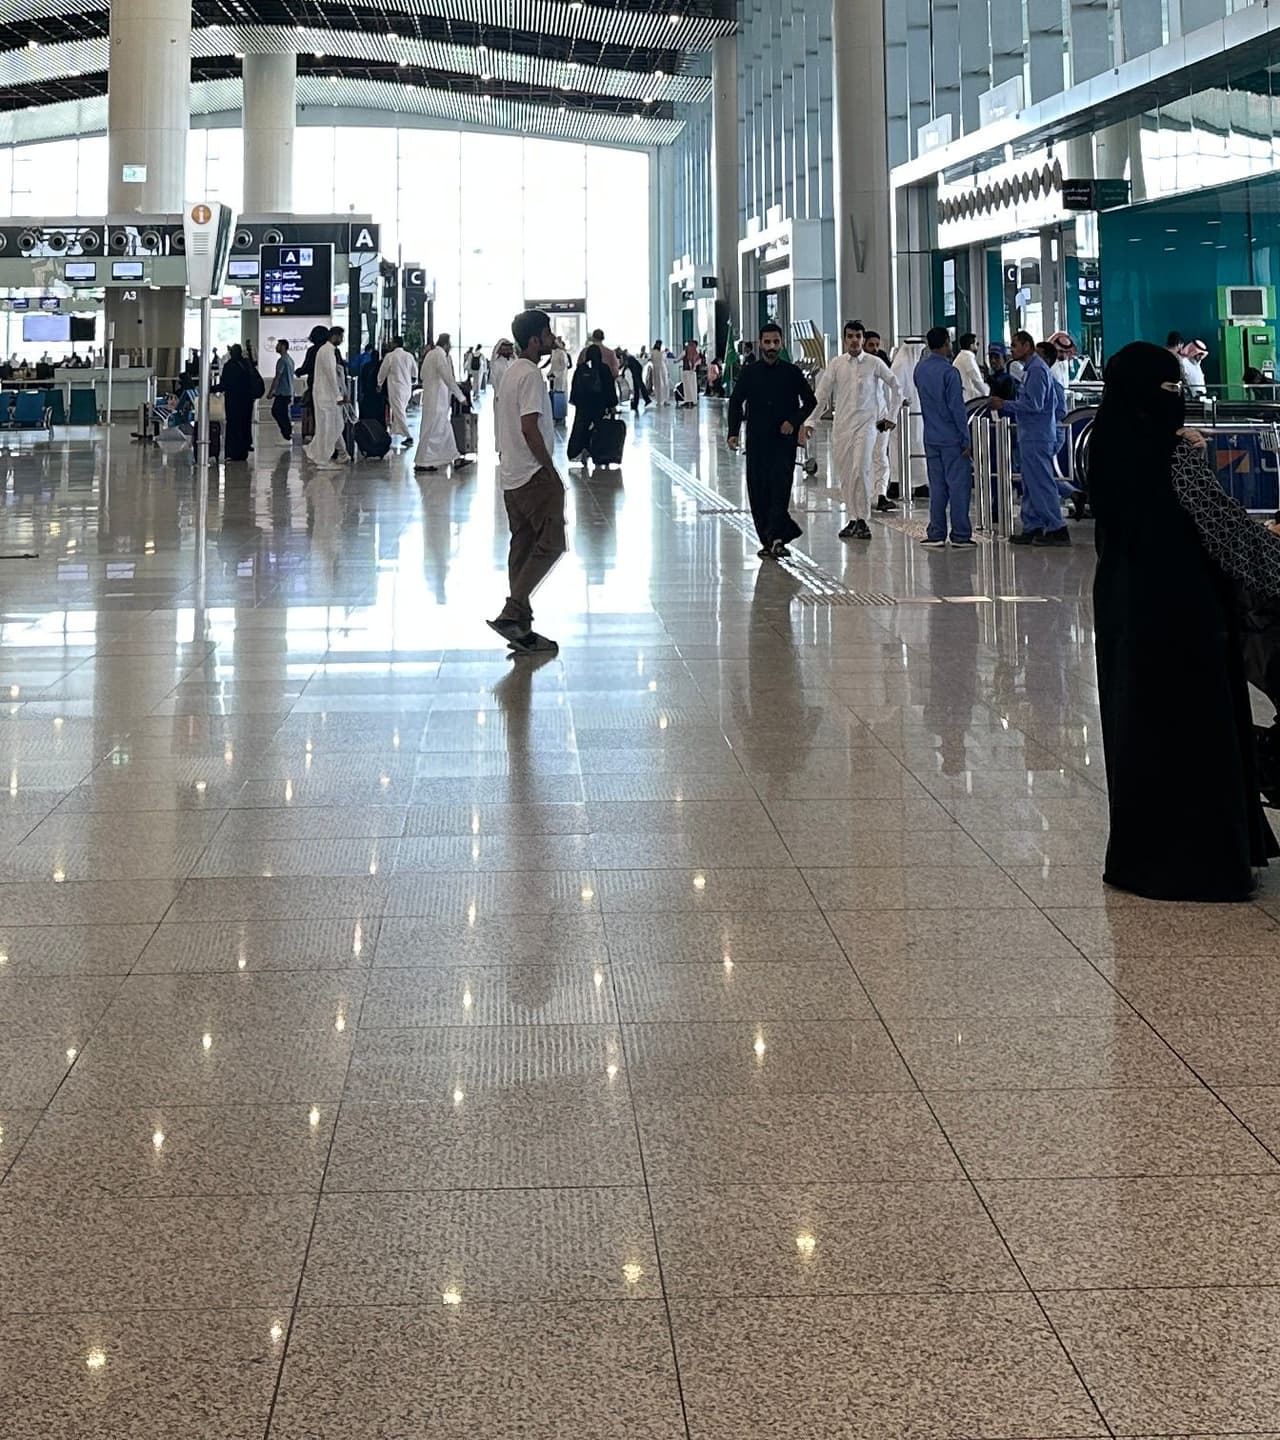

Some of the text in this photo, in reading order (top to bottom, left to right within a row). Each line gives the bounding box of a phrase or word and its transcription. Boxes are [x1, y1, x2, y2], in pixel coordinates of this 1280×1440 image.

[355, 229, 374, 248] A
[285, 251, 297, 263] A
[411, 271, 422, 285] C
[123, 291, 137, 301] A3
